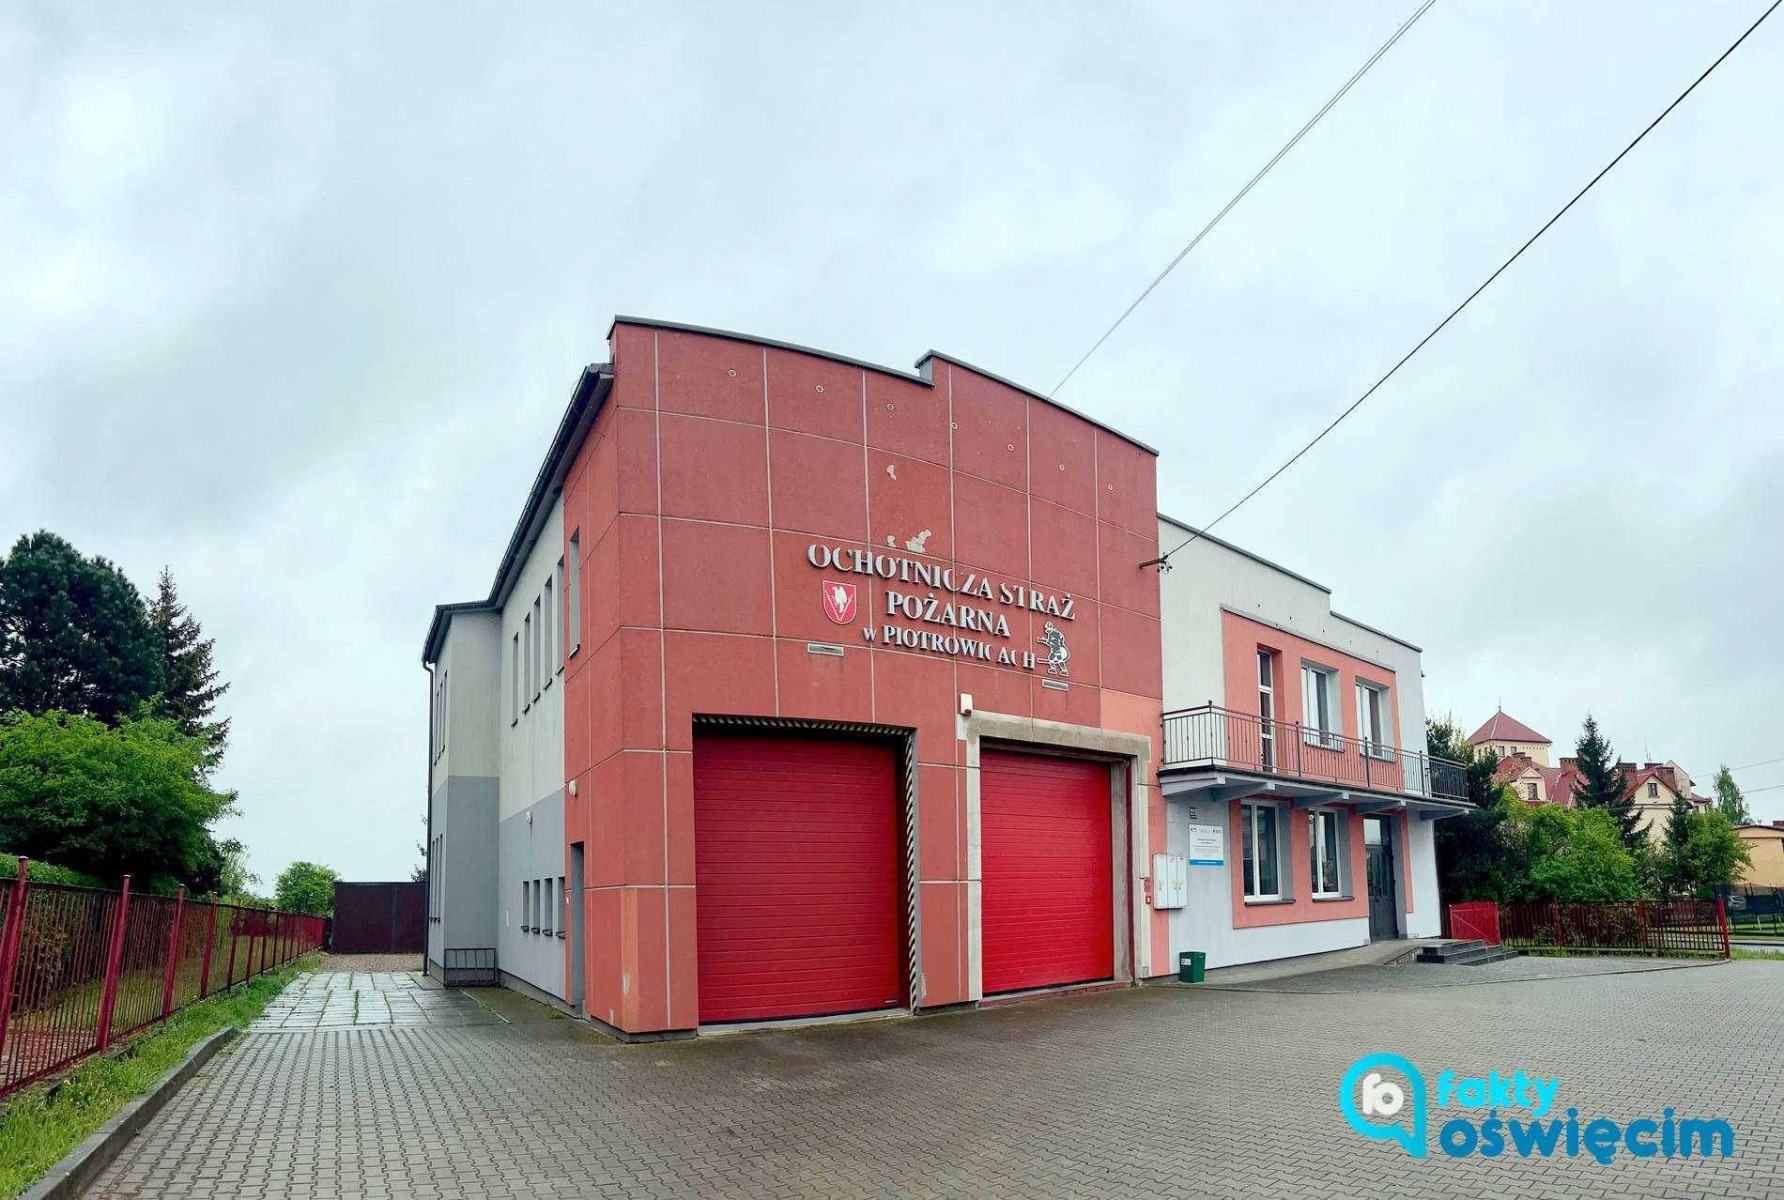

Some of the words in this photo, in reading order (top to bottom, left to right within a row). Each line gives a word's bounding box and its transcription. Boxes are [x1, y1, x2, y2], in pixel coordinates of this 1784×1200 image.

[807, 543, 994, 600] OCHOTNICZA
[999, 581, 1076, 620] STRAŻ
[886, 591, 1011, 638] POŻARNA
